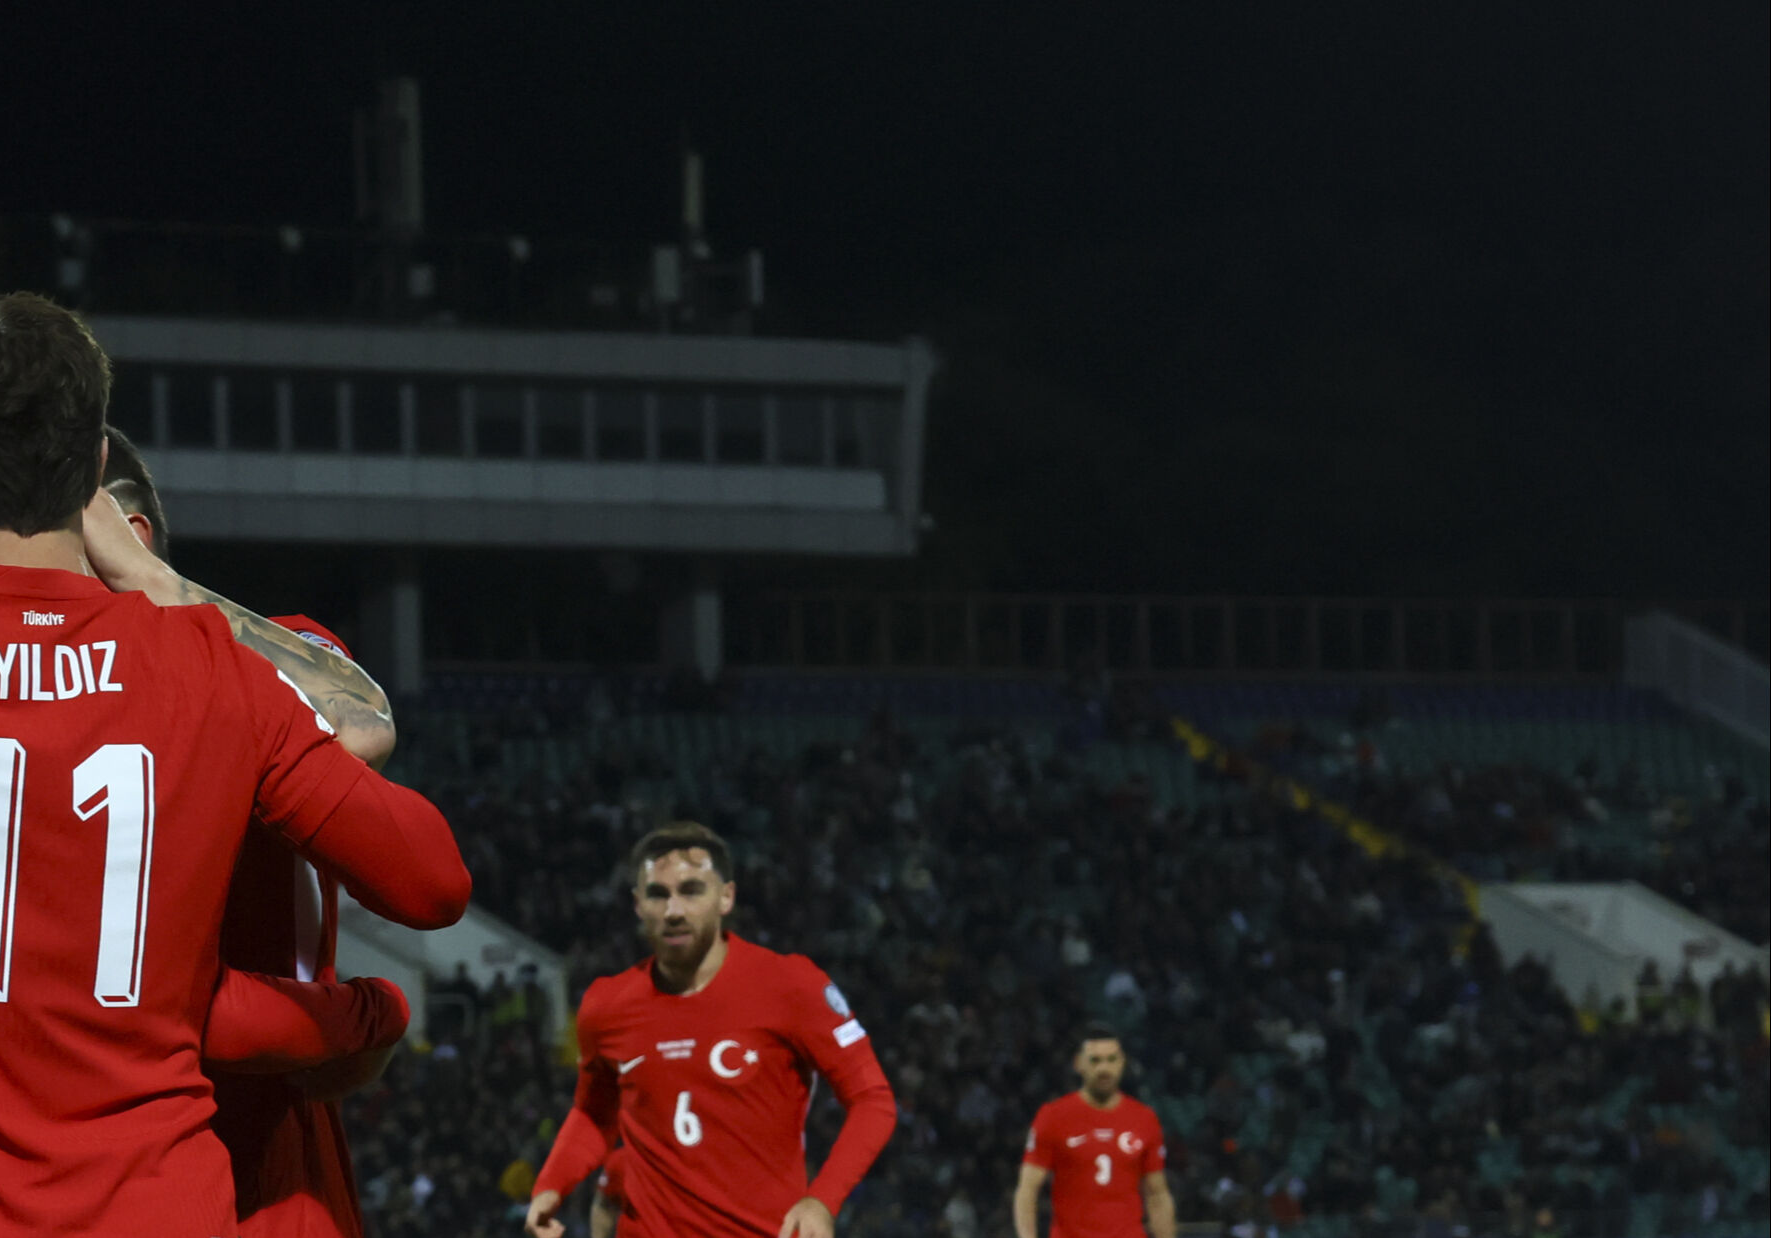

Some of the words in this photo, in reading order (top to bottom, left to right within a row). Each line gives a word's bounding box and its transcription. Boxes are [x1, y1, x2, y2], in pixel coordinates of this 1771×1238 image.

[21, 609, 66, 626] TÜRKİYE
[674, 1091, 703, 1147] 6
[1094, 1153, 1112, 1186] 3
